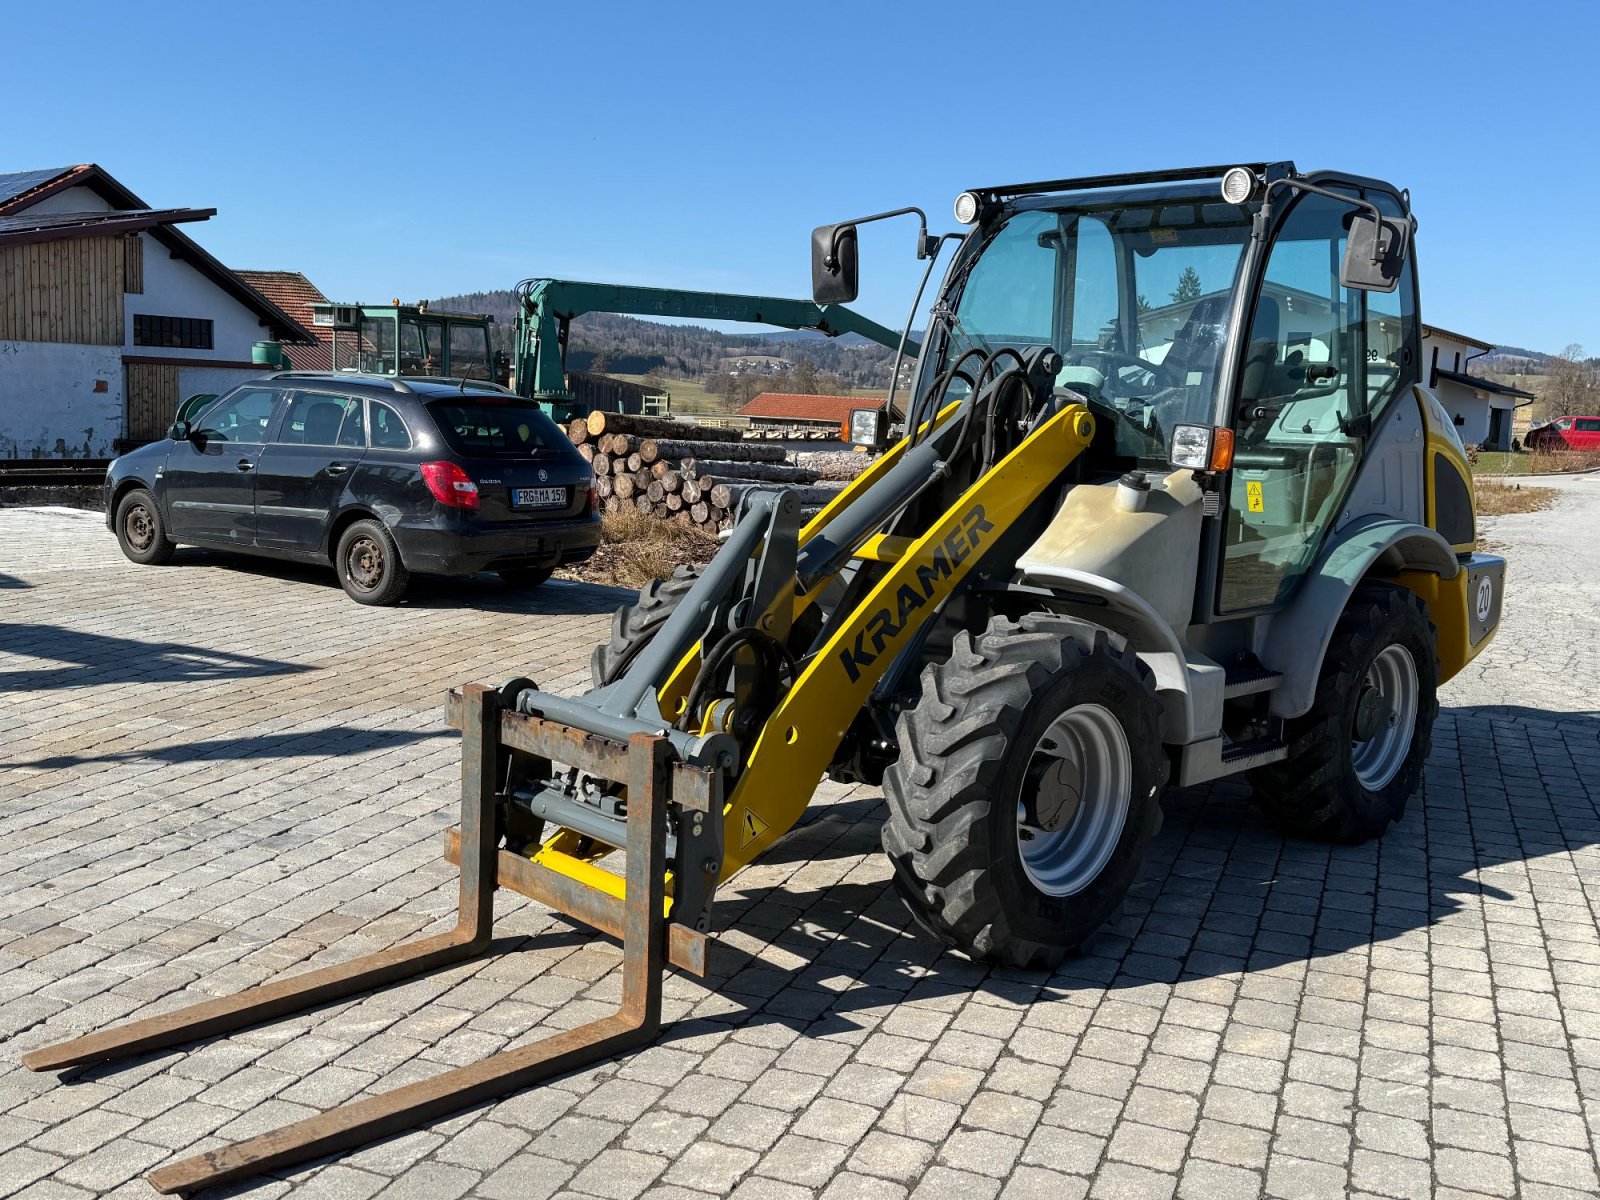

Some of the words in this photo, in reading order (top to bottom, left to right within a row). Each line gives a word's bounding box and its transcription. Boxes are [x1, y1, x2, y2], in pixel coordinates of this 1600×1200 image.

[518, 490, 534, 503] FRG
[540, 489, 550, 502] MA
[551, 489, 566, 502] 159
[839, 503, 995, 684] KRAMER
[1478, 584, 1490, 613] 20
